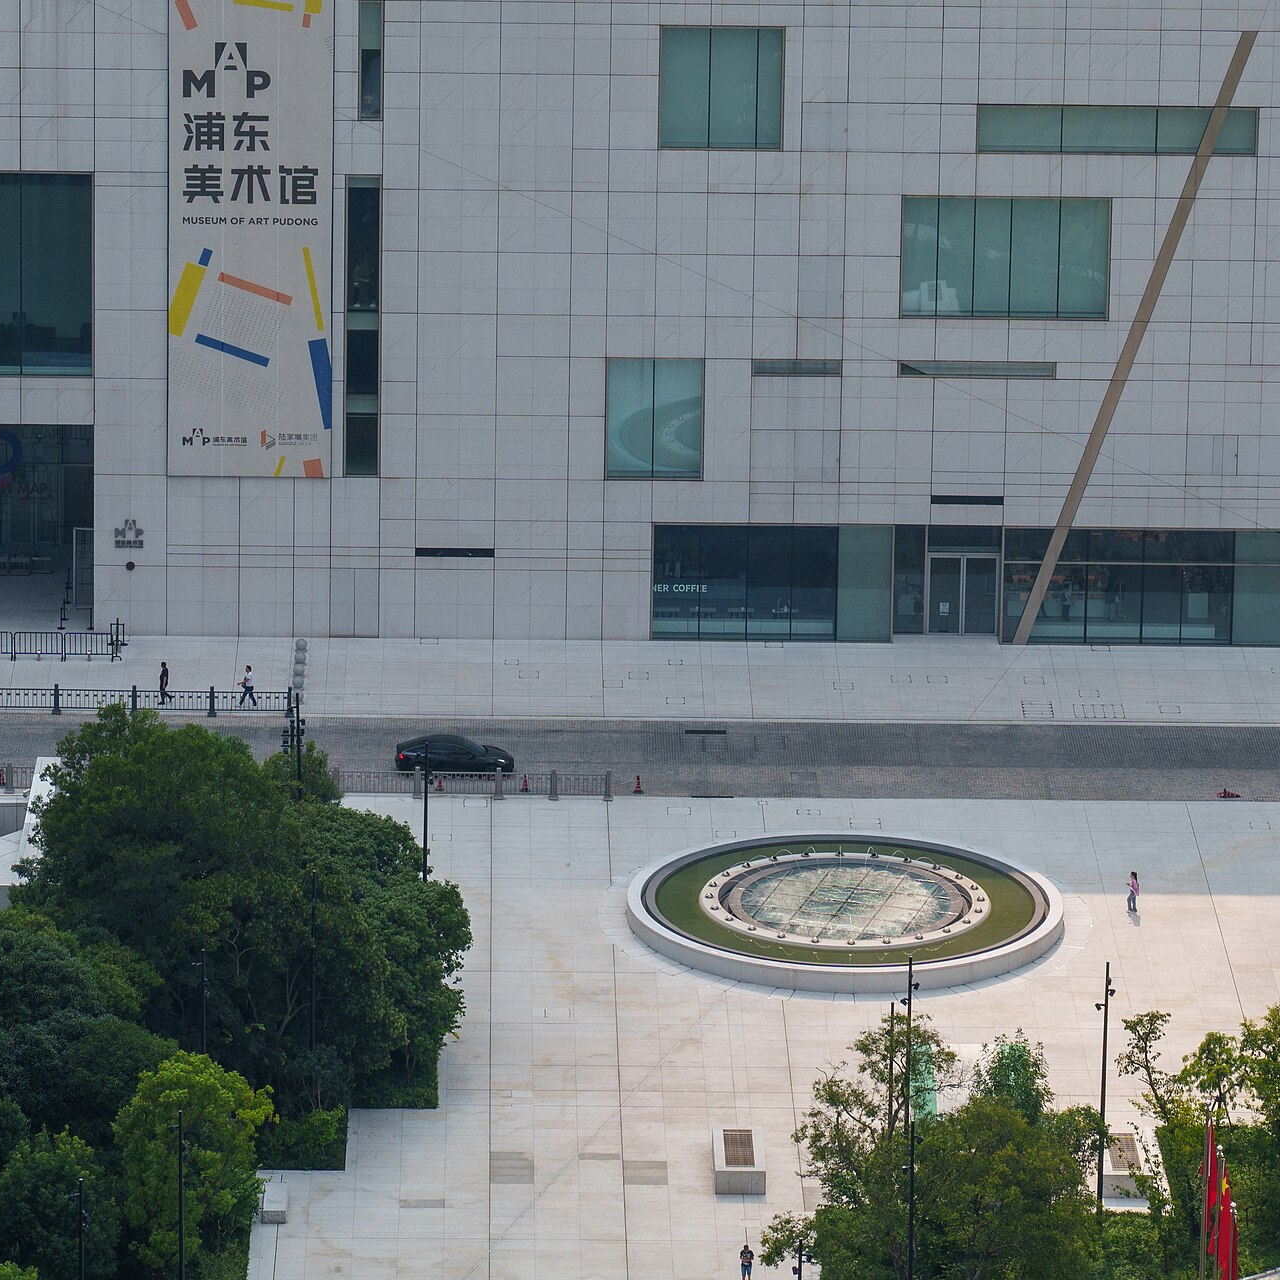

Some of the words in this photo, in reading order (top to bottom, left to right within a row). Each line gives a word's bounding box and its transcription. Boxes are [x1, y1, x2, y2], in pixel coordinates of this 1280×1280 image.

[182, 42, 271, 98] MAP
[182, 111, 271, 152] 浦东
[182, 164, 319, 205] 美术馆
[182, 216, 227, 225] MUSEUM
[230, 217, 245, 225] OF
[248, 217, 269, 225] ART
[272, 217, 319, 226] PUDONG
[182, 428, 211, 446] MAP
[114, 519, 144, 538] MAP
